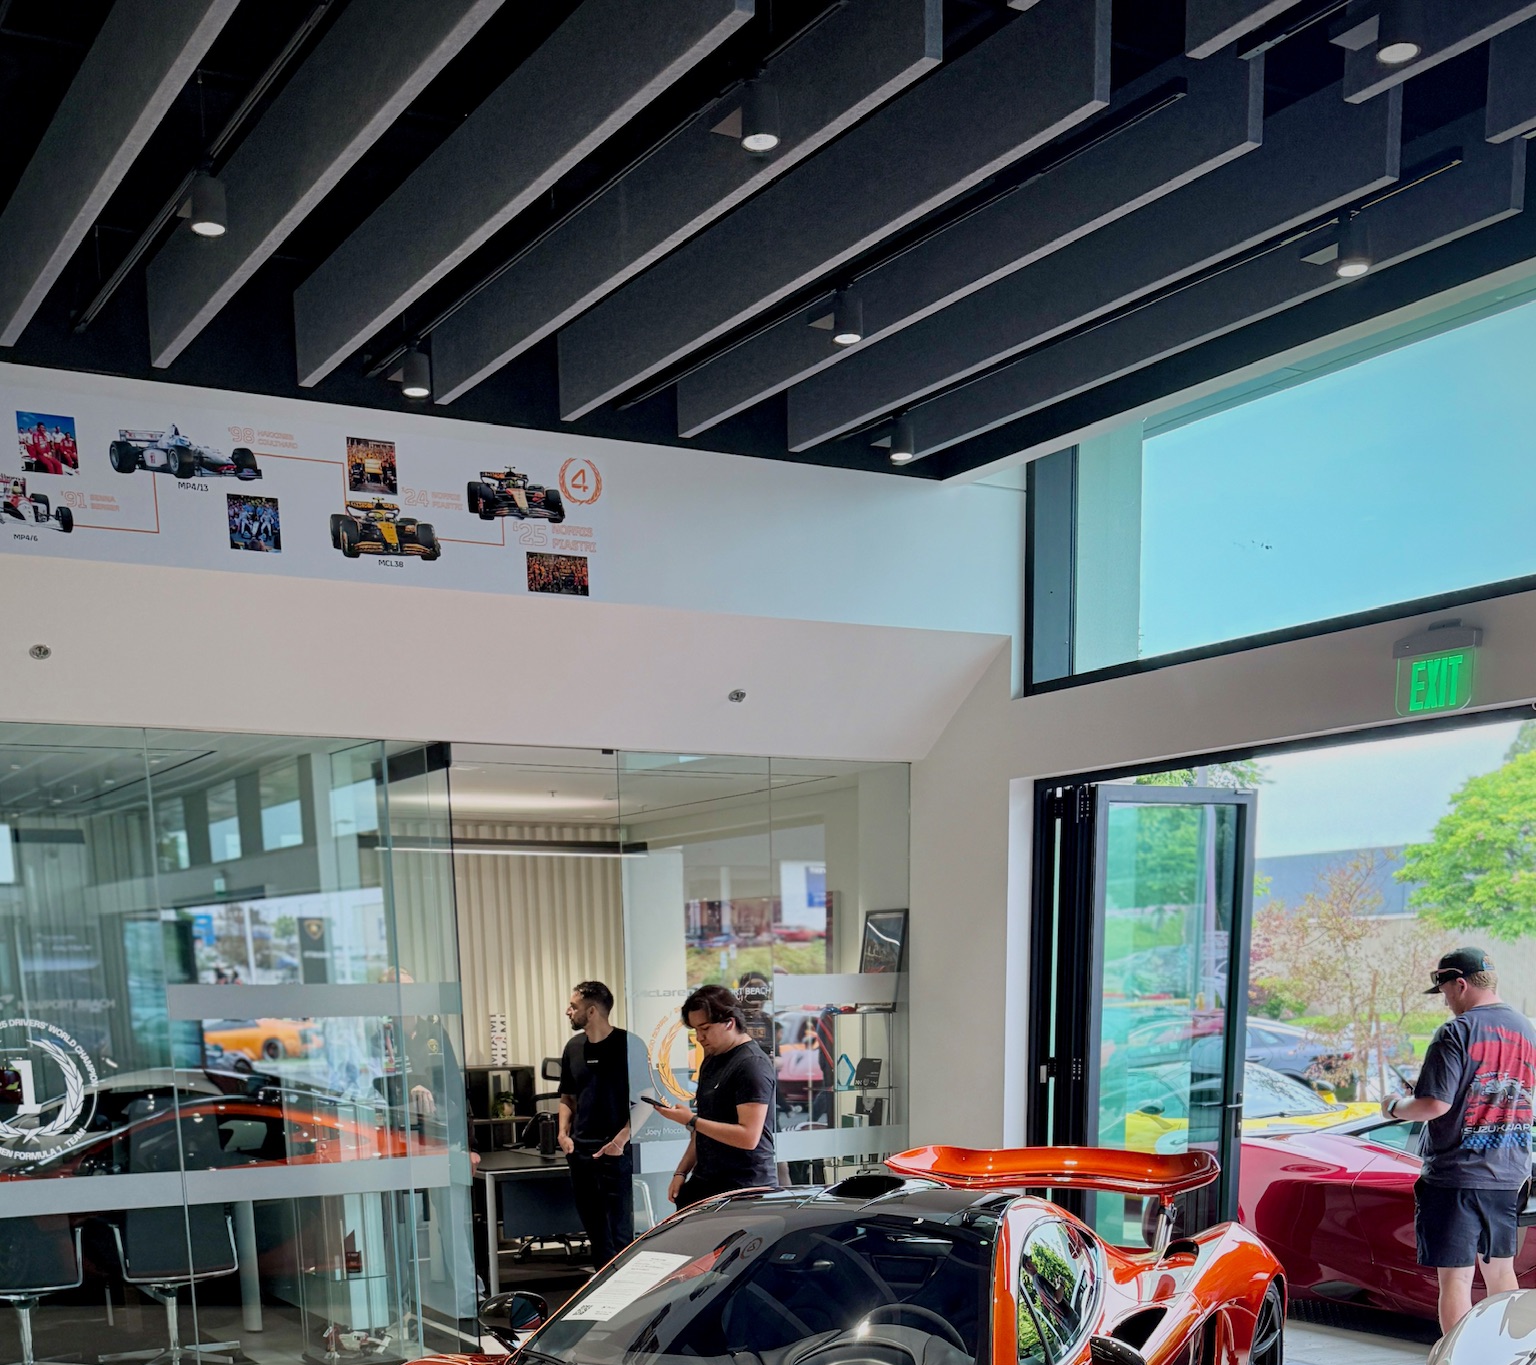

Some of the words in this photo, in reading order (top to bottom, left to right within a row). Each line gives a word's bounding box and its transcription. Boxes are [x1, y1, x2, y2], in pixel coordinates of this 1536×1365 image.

[177, 481, 209, 492] MP4/13
[571, 468, 589, 493] 4
[60, 490, 88, 509] '91
[13, 533, 39, 542] MP4/6
[512, 521, 548, 547] '25
[551, 524, 593, 537] NORRIS
[552, 538, 597, 553] PIASTRI
[378, 559, 404, 568] MCL38
[1409, 654, 1464, 712] EXIT
[632, 988, 694, 998] McLare
[744, 986, 770, 996] BEACH
[48, 1024, 77, 1048] WORLD
[74, 1044, 99, 1088] CHAMPION
[9, 1059, 43, 1115] 1
[644, 1128, 662, 1137] Joey
[13, 1147, 57, 1161] FORMULA
[63, 1127, 87, 1148] TEAM
